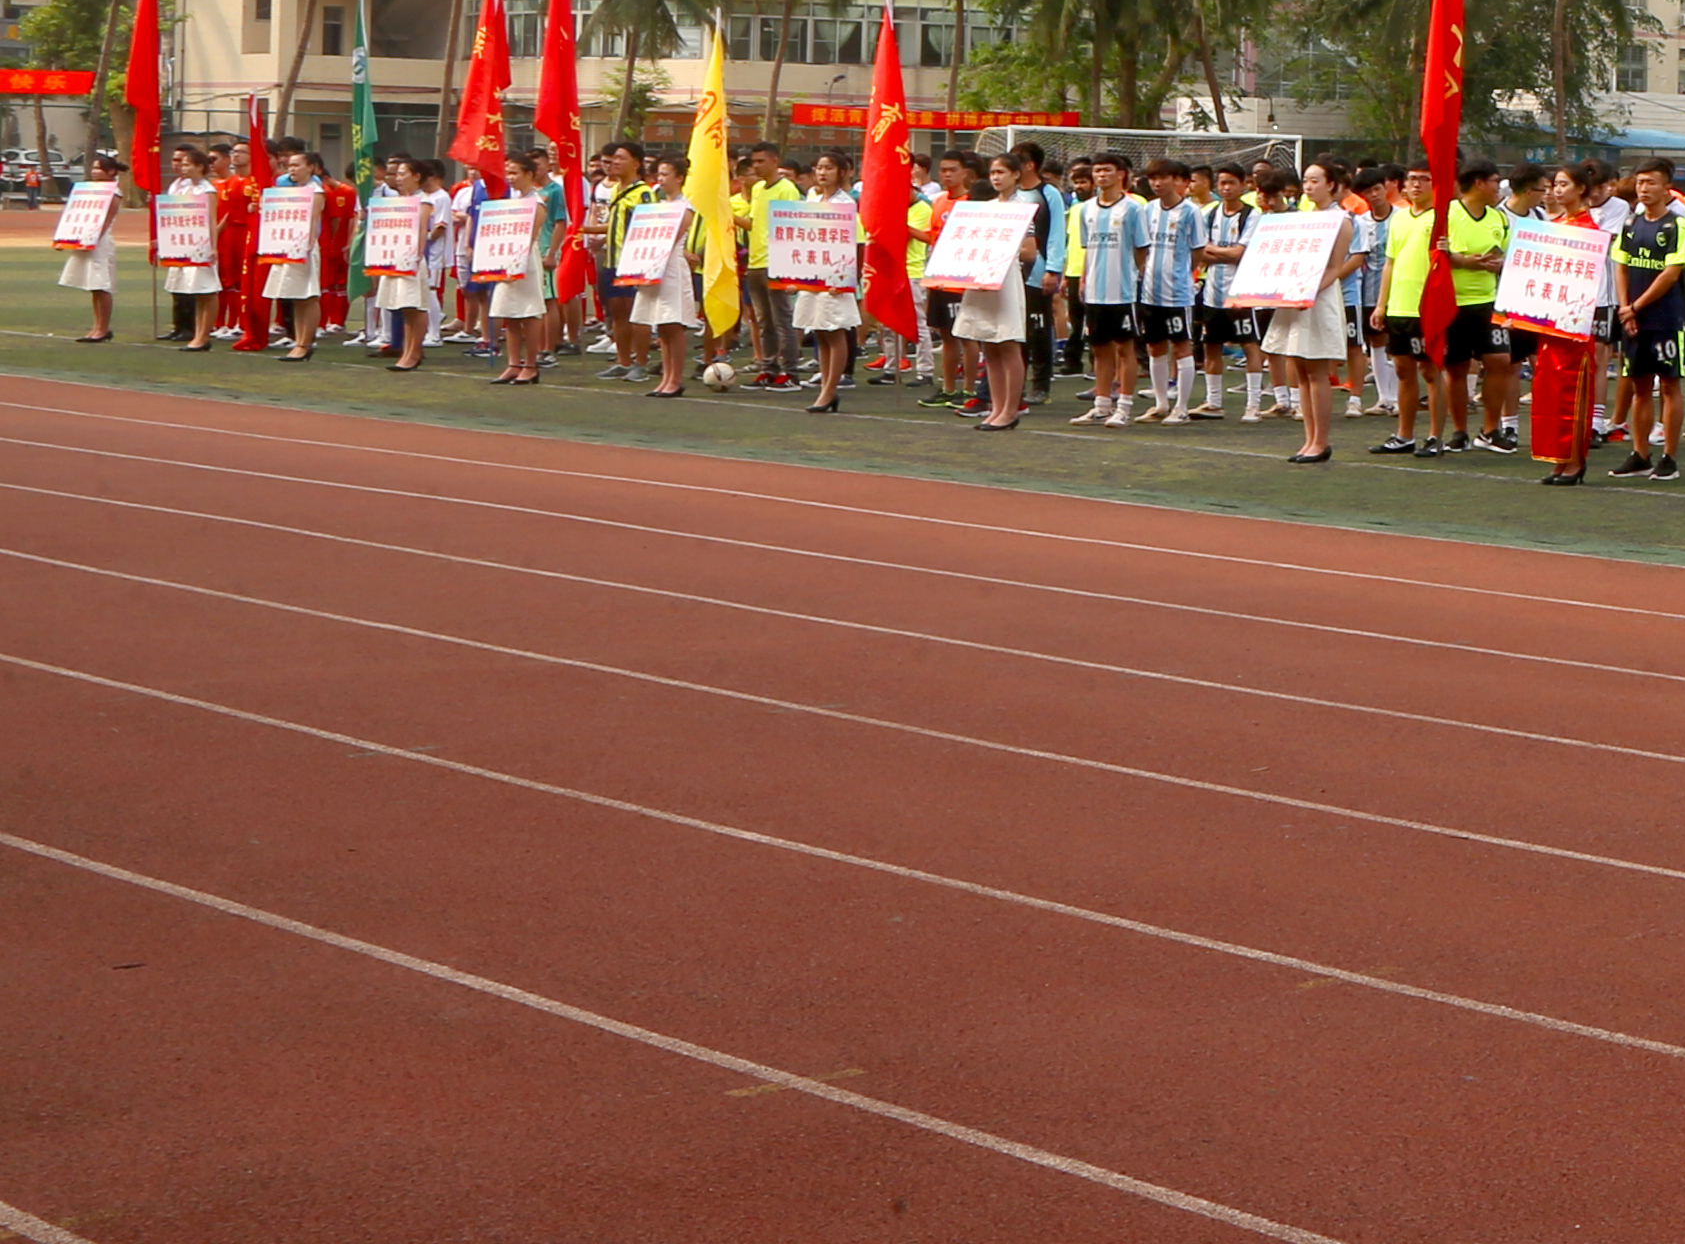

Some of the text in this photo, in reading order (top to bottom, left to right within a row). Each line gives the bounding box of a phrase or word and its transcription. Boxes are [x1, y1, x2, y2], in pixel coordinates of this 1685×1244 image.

[775, 225, 851, 244] 教育与心理学院
[950, 225, 1015, 242] 美术学院
[953, 247, 992, 263] 代表队
[1257, 238, 1323, 255] 外国语学院
[792, 248, 832, 266] 代表队
[1512, 247, 1597, 280] 信息科学技术学院
[1259, 261, 1300, 278] 代表队
[1524, 279, 1569, 305] 代表队
[1121, 314, 1131, 331] 4
[1234, 319, 1252, 335] 15
[1492, 328, 1510, 346] 88
[1655, 340, 1677, 361] 10
